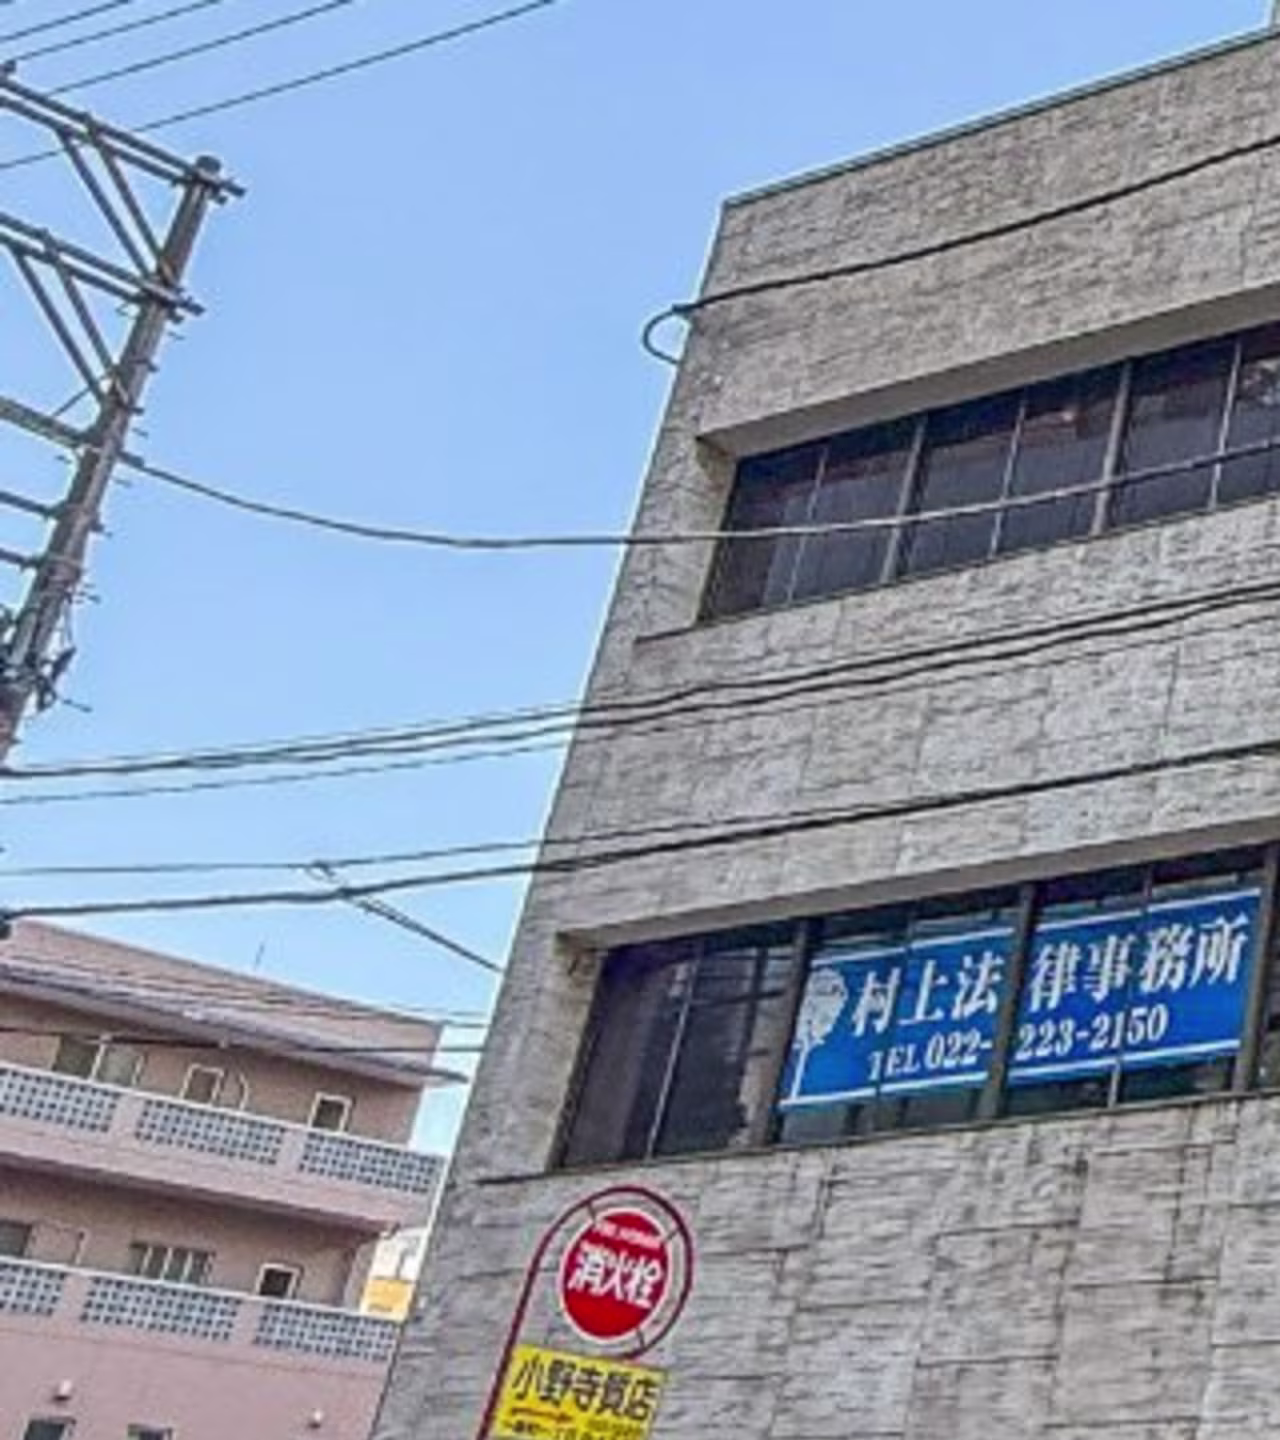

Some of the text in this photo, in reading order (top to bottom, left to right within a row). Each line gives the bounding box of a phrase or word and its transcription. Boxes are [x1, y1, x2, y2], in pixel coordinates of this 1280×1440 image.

[850, 913, 1250, 1037] 村上法律事務所
[567, 1241, 662, 1309] 消火栓
